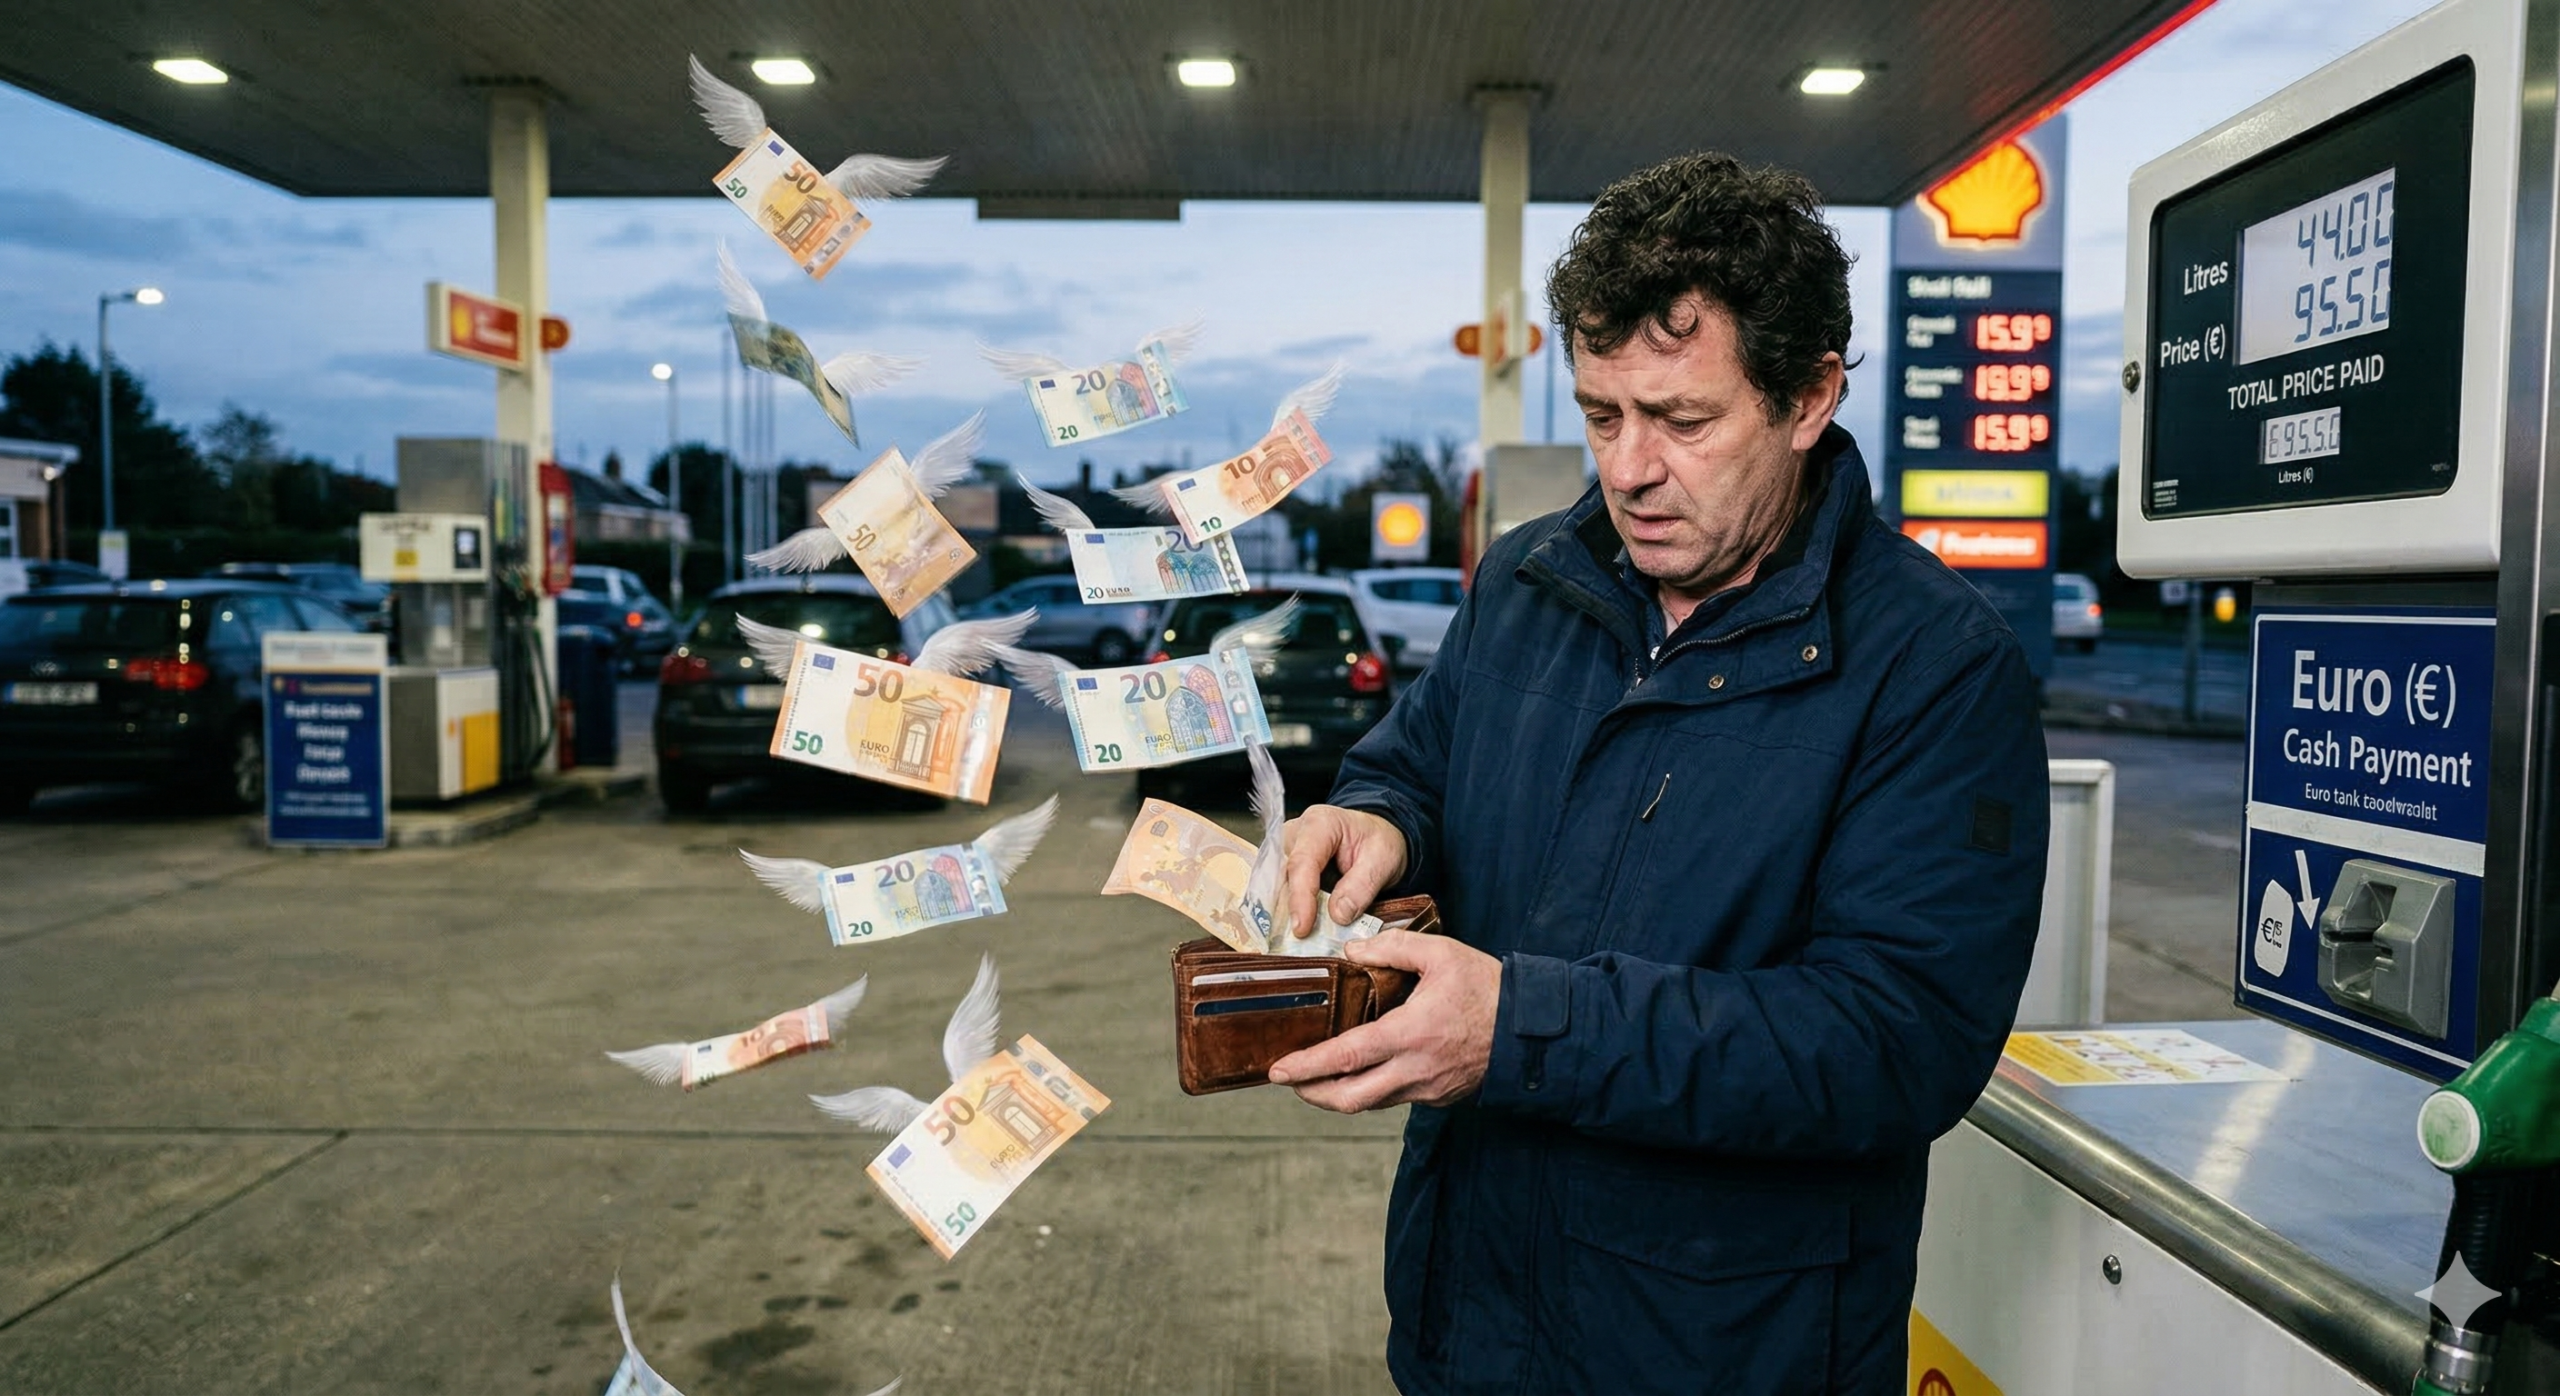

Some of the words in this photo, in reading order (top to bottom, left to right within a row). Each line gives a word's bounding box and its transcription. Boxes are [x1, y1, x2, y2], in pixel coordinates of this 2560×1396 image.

[725, 177, 748, 199] 50
[783, 161, 818, 194] 50
[2183, 261, 2229, 295] Litres
[2160, 336, 2200, 367] Price
[2204, 324, 2226, 362] (€)
[1071, 370, 1106, 395] 20
[2228, 378, 2278, 410] TOTAL
[2282, 364, 2335, 399] PRICE
[2340, 354, 2384, 388] PAID
[1057, 425, 1078, 440] 20
[1224, 456, 1256, 480] 10
[847, 524, 876, 552] 50
[1200, 517, 1222, 533] 10
[1086, 587, 1104, 599] 20
[853, 663, 904, 703] 50
[1120, 671, 1166, 704] 20
[2293, 650, 2392, 716] Euro
[2405, 663, 2456, 728] (€)
[792, 731, 823, 755] 50
[1095, 743, 1122, 763] 20
[2283, 728, 2340, 768] Cash
[2350, 735, 2472, 787] Payment
[2305, 783, 2331, 802] Euro
[2333, 788, 2360, 807] tank
[875, 860, 915, 888] 20
[848, 921, 873, 938] 20
[923, 1095, 976, 1147] 50
[945, 1202, 977, 1236] 50
